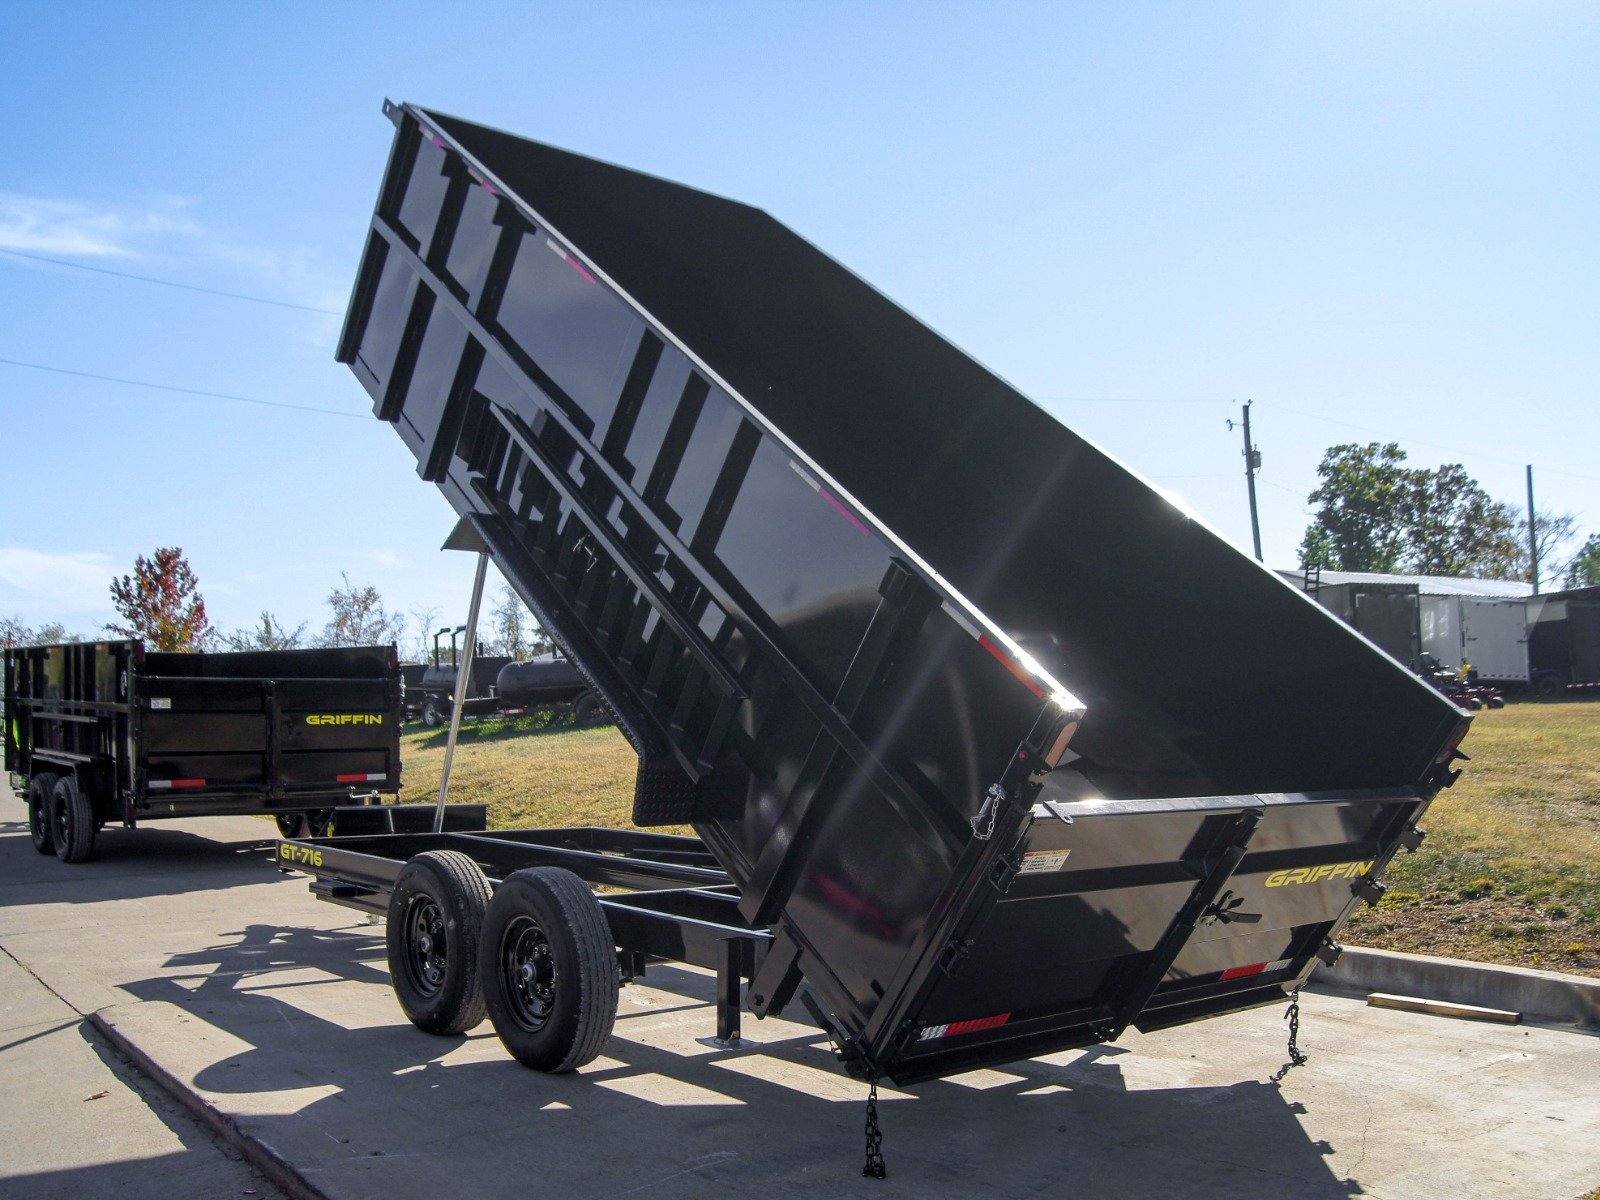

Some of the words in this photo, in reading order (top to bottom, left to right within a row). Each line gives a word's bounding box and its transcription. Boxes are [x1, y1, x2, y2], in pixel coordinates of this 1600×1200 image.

[305, 714, 382, 725] GRIFFIN
[280, 843, 323, 867] GT-716
[1265, 860, 1375, 888] GRIFFIN
